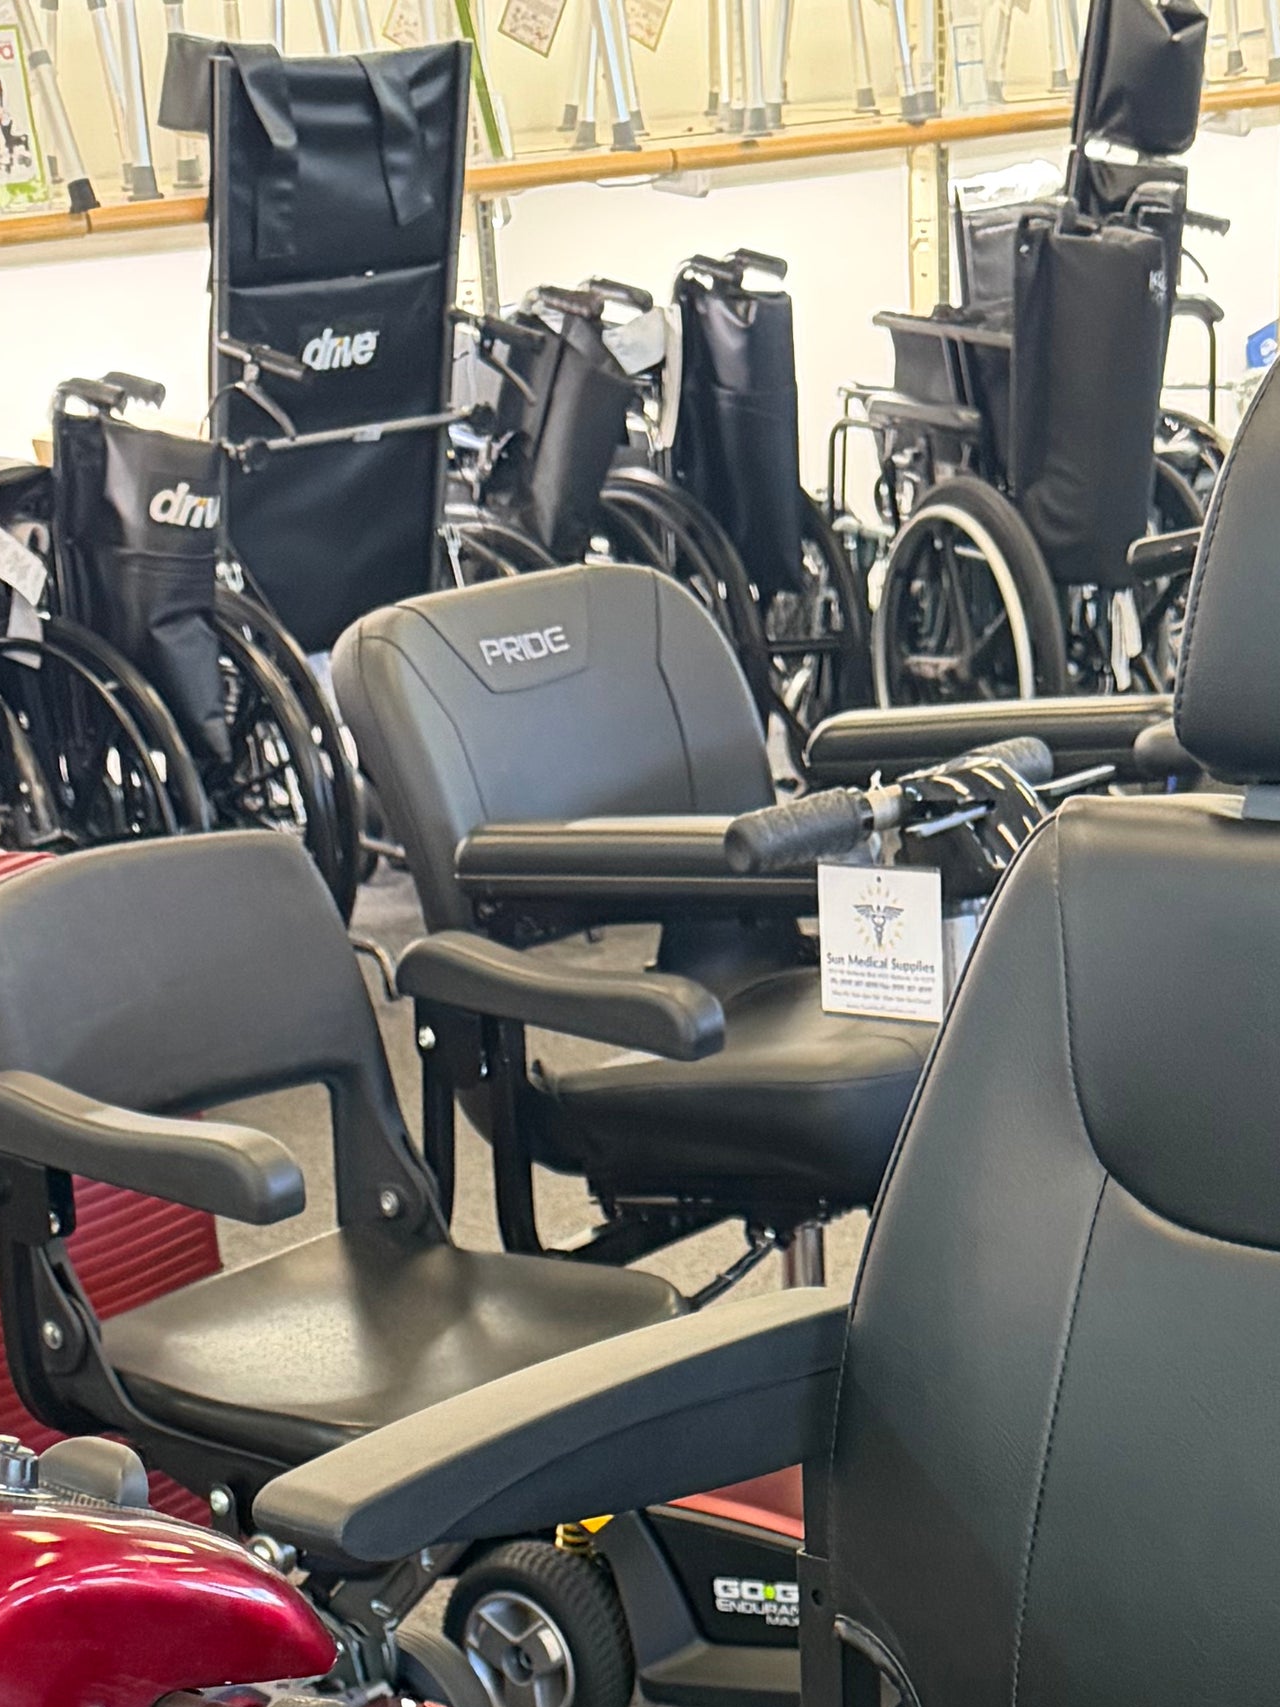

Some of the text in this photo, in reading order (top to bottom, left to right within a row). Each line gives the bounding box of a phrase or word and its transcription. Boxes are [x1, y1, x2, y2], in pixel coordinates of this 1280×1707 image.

[302, 327, 379, 371] drive
[479, 625, 571, 667] PRIDE
[826, 952, 936, 974] Sun Medical Supplies
